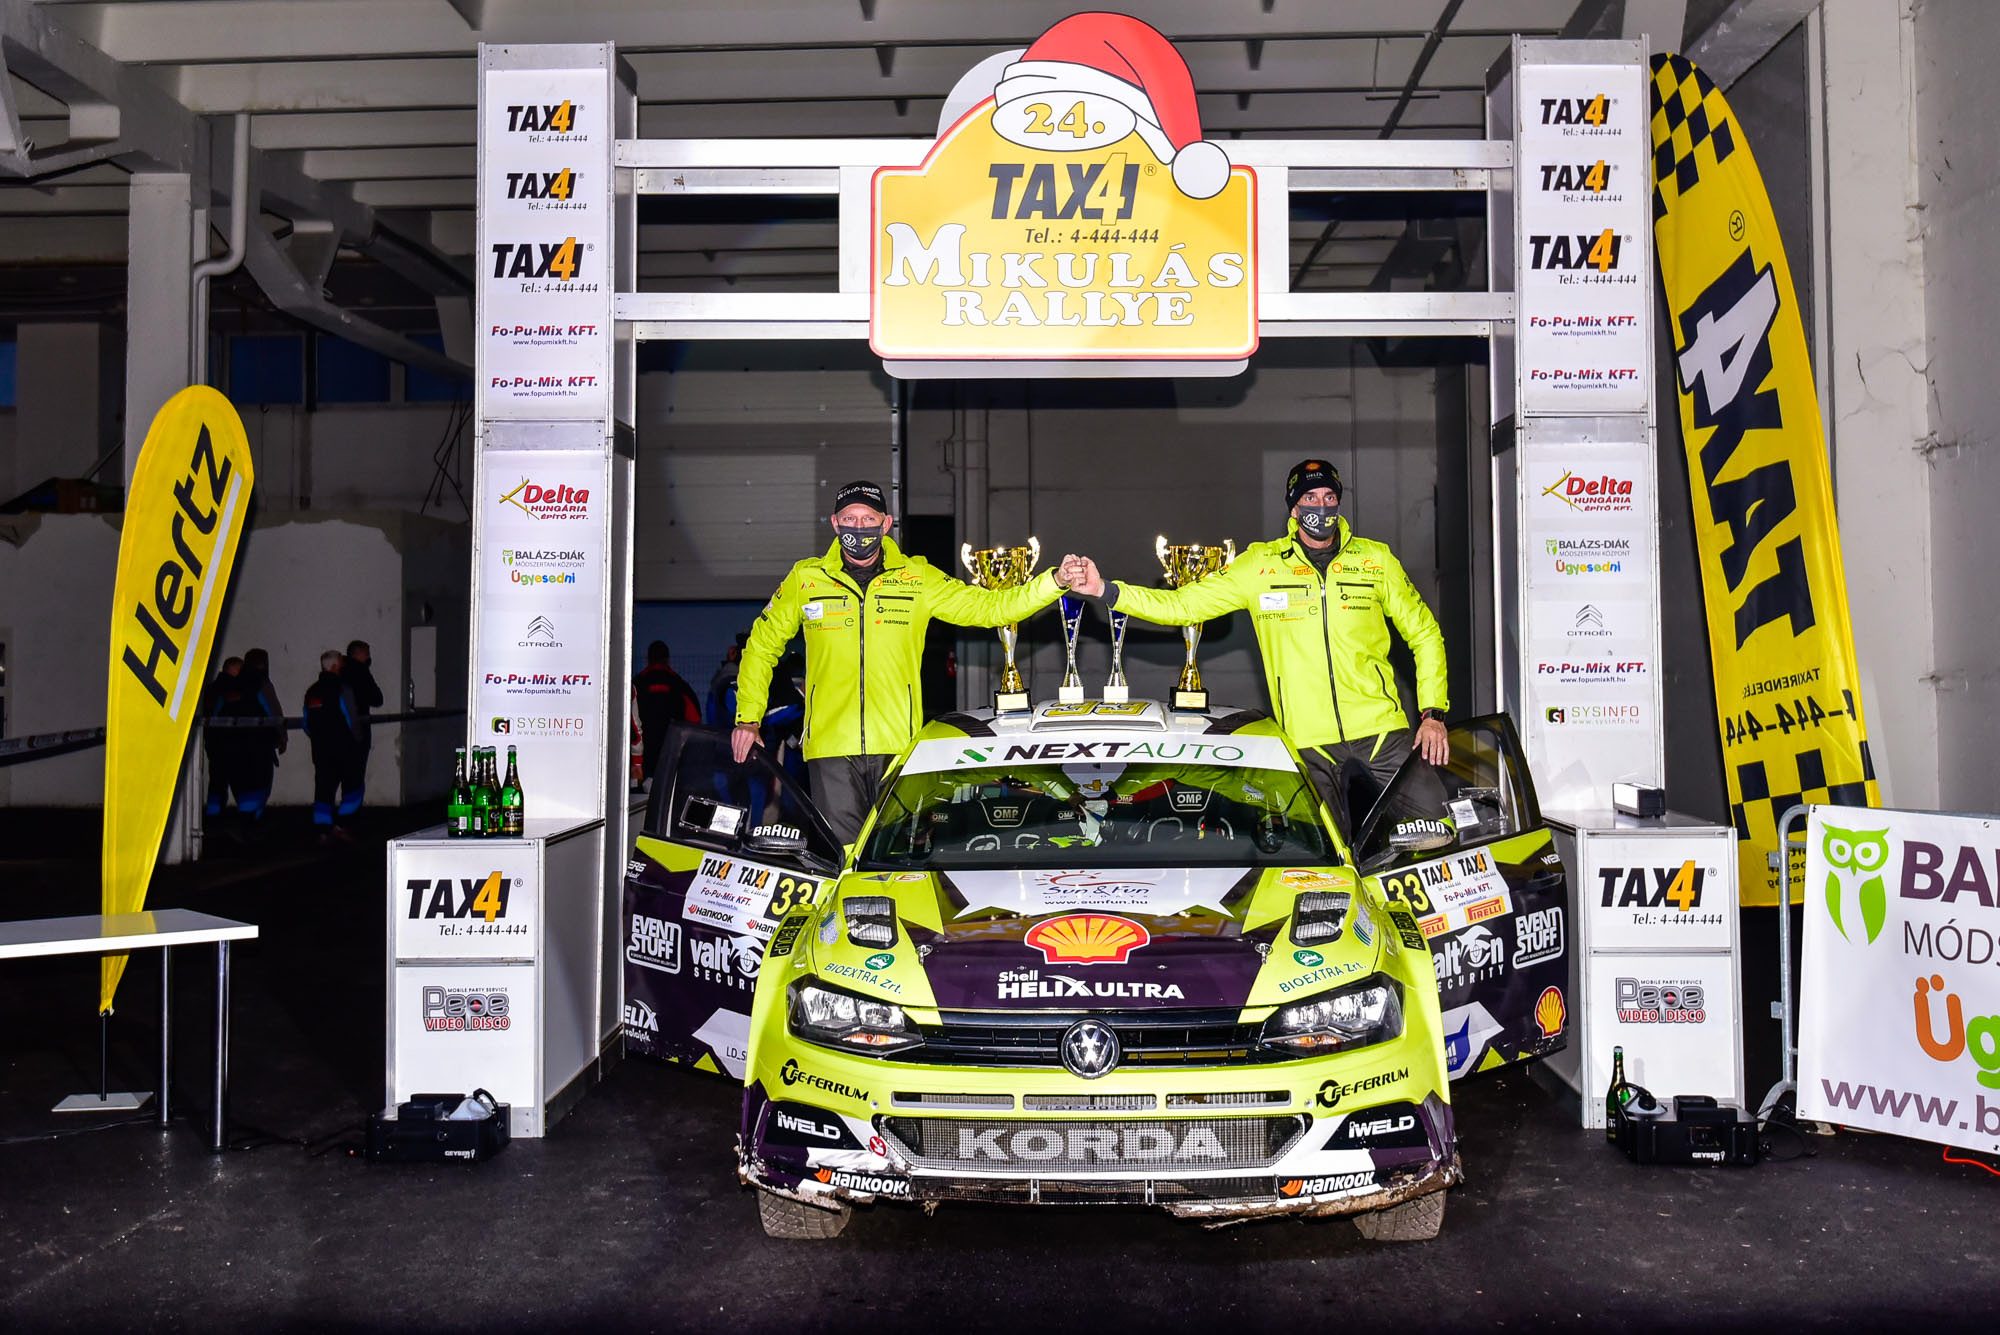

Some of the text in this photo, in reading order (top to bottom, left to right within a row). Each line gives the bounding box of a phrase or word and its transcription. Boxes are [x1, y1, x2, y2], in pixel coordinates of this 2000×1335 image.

[1024, 101, 1105, 138] 24.
[1562, 128, 1622, 136] Tel.: 4-444-444
[1563, 194, 1622, 202] Tel.: 4-444-444
[1025, 228, 1159, 243] Tel.: 4-444-444
[884, 222, 1245, 289] MIKULÁS
[520, 283, 598, 293] Tel.: 4-444-444
[1558, 274, 1637, 285] Tel.: 4-444-444
[942, 291, 1195, 327] RALLYE
[1530, 316, 1637, 327] Fo-Pu-Mix KFT.
[491, 325, 598, 336] Fo-Pu-Mix KFT.
[491, 376, 598, 388] Fo-Pu-Mix KFT.
[1531, 369, 1638, 380] Fo-Pu-Mix KFT.
[523, 484, 590, 504] Delta
[1566, 476, 1632, 495] Delta
[530, 504, 588, 512] HUNGÁRIA
[1573, 496, 1631, 504] HUNGÁRIA
[1558, 538, 1630, 549] BALÁZS-DIÁK
[515, 550, 585, 560] BALÁZS-DIÁK
[122, 422, 232, 709] Hertz
[1556, 560, 1621, 575] Ügyesedni
[511, 570, 575, 585] Ügyesedni
[1538, 662, 1646, 674] Fo-Pu-Mix KFT.
[485, 674, 592, 685] Fo-Pu-Mix KFT.
[1571, 705, 1639, 718] SYSINFO
[517, 717, 584, 729] SYSINFO
[1177, 794, 1202, 804] OMP
[994, 809, 1018, 818] OMP
[700, 887, 735, 902] Fo-Pu-Mix
[735, 895, 752, 906] KFT.
[771, 878, 813, 916] 33
[1388, 873, 1429, 911] 33
[1444, 887, 1477, 903] Fo-Pu-Mix
[1477, 883, 1493, 893] KFT.
[1468, 899, 1502, 921] PIRELLI
[632, 914, 676, 941] EVENT
[1515, 911, 1558, 936] EVENT
[1632, 913, 1723, 926] Tel.: 4-444-444
[438, 923, 527, 937] Tel.: 4-444-444
[632, 933, 674, 959] STUFF
[1517, 929, 1557, 954] STUFF
[694, 967, 754, 993] SECURI
[824, 962, 902, 994] BIOEXTRA Zrt.
[998, 969, 1039, 983] Shell
[1279, 961, 1368, 994] BIOEXTRA Zrt.
[1438, 964, 1504, 992] ECURITY
[998, 975, 1185, 999] HELIX ULTRA
[423, 986, 509, 1030] Pepe
[1616, 978, 1704, 1022] Pepe
[425, 1016, 510, 1030] VIDEO DISCO
[625, 999, 659, 1032] ELIX
[1619, 1009, 1704, 1022] VIDEO DISCO
[777, 1111, 841, 1140] iWELD
[1348, 1115, 1415, 1139] iWELD
[959, 1127, 1227, 1160] KORDA
